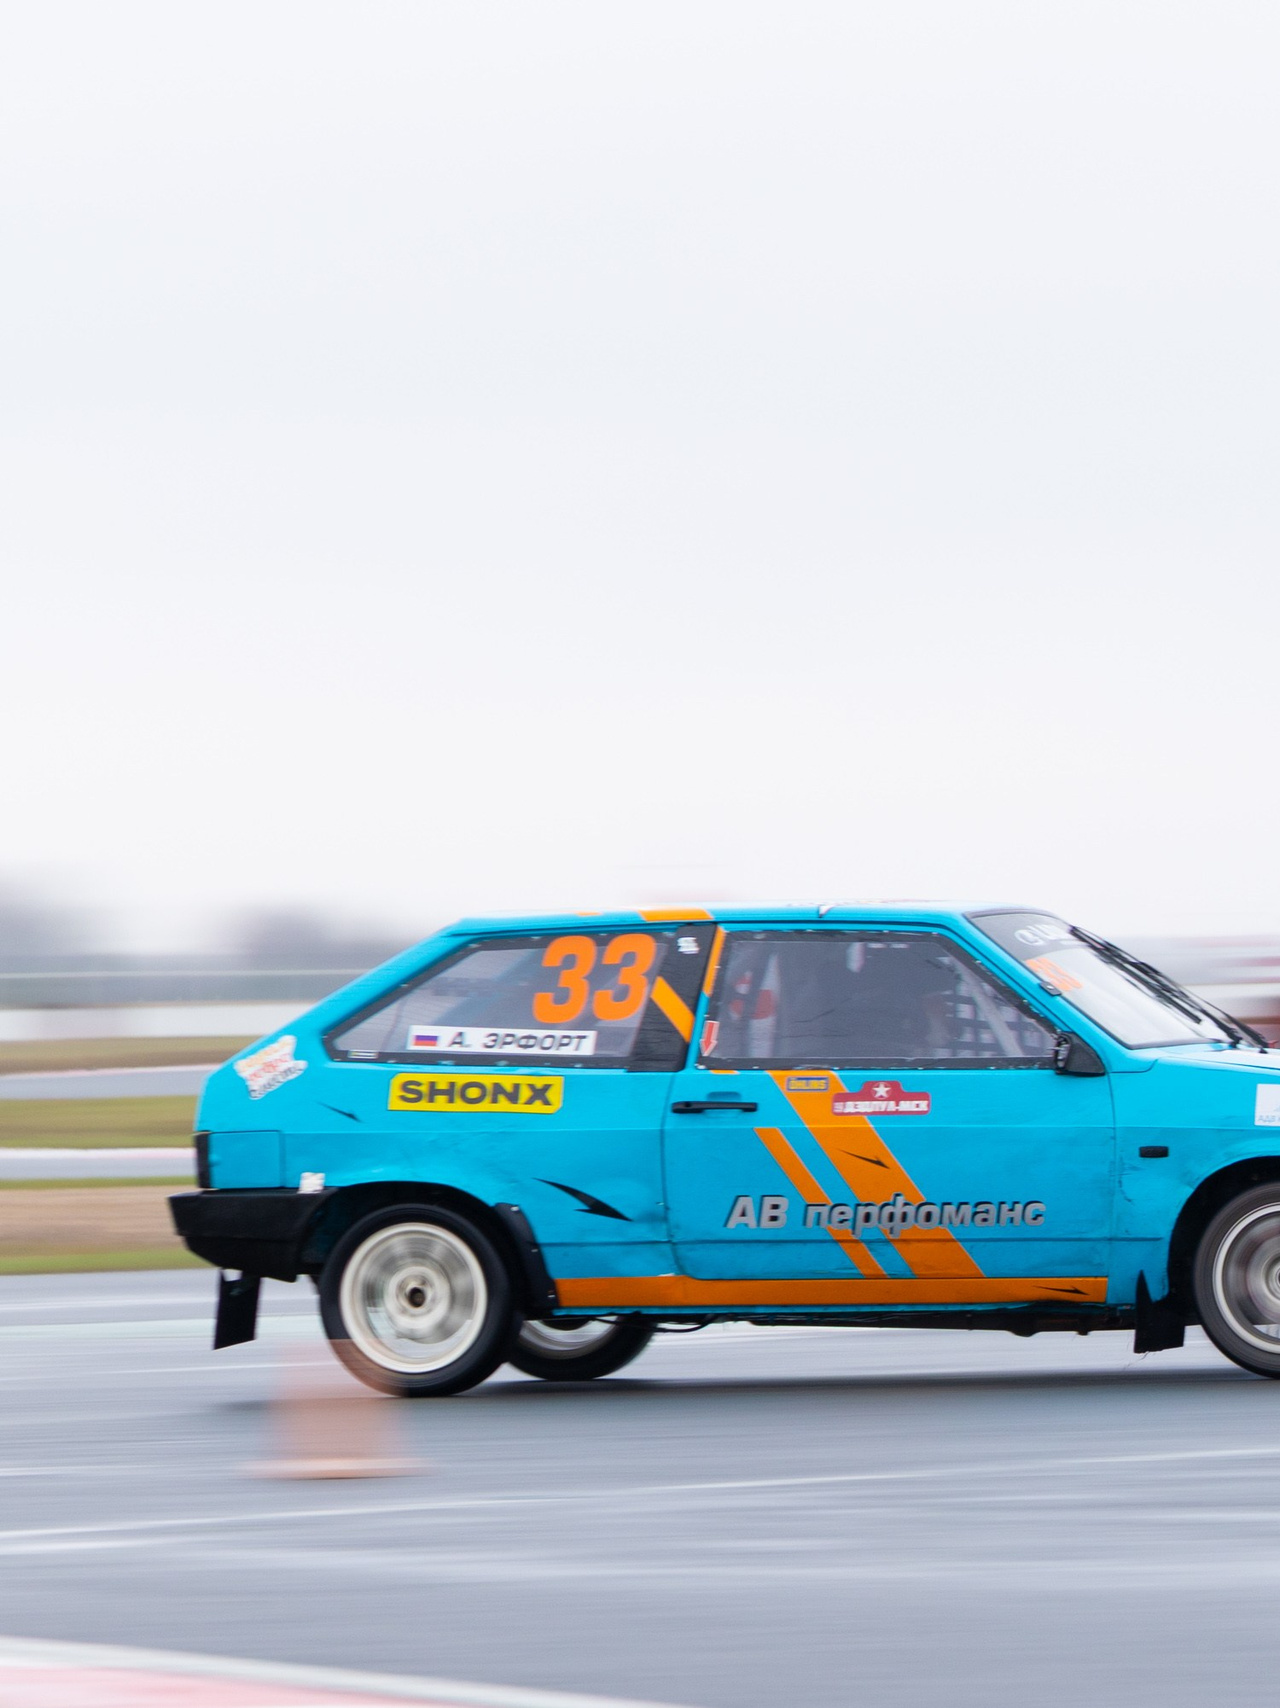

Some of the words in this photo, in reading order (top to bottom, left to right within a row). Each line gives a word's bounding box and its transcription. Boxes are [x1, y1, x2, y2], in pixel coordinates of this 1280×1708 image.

[532, 933, 656, 1023] 33
[449, 1032, 471, 1048] А.
[484, 1033, 588, 1052] ЭРФОРТ
[399, 1080, 554, 1107] SHONX
[724, 1194, 789, 1230] АВ
[803, 1192, 1047, 1238] перфоманс
